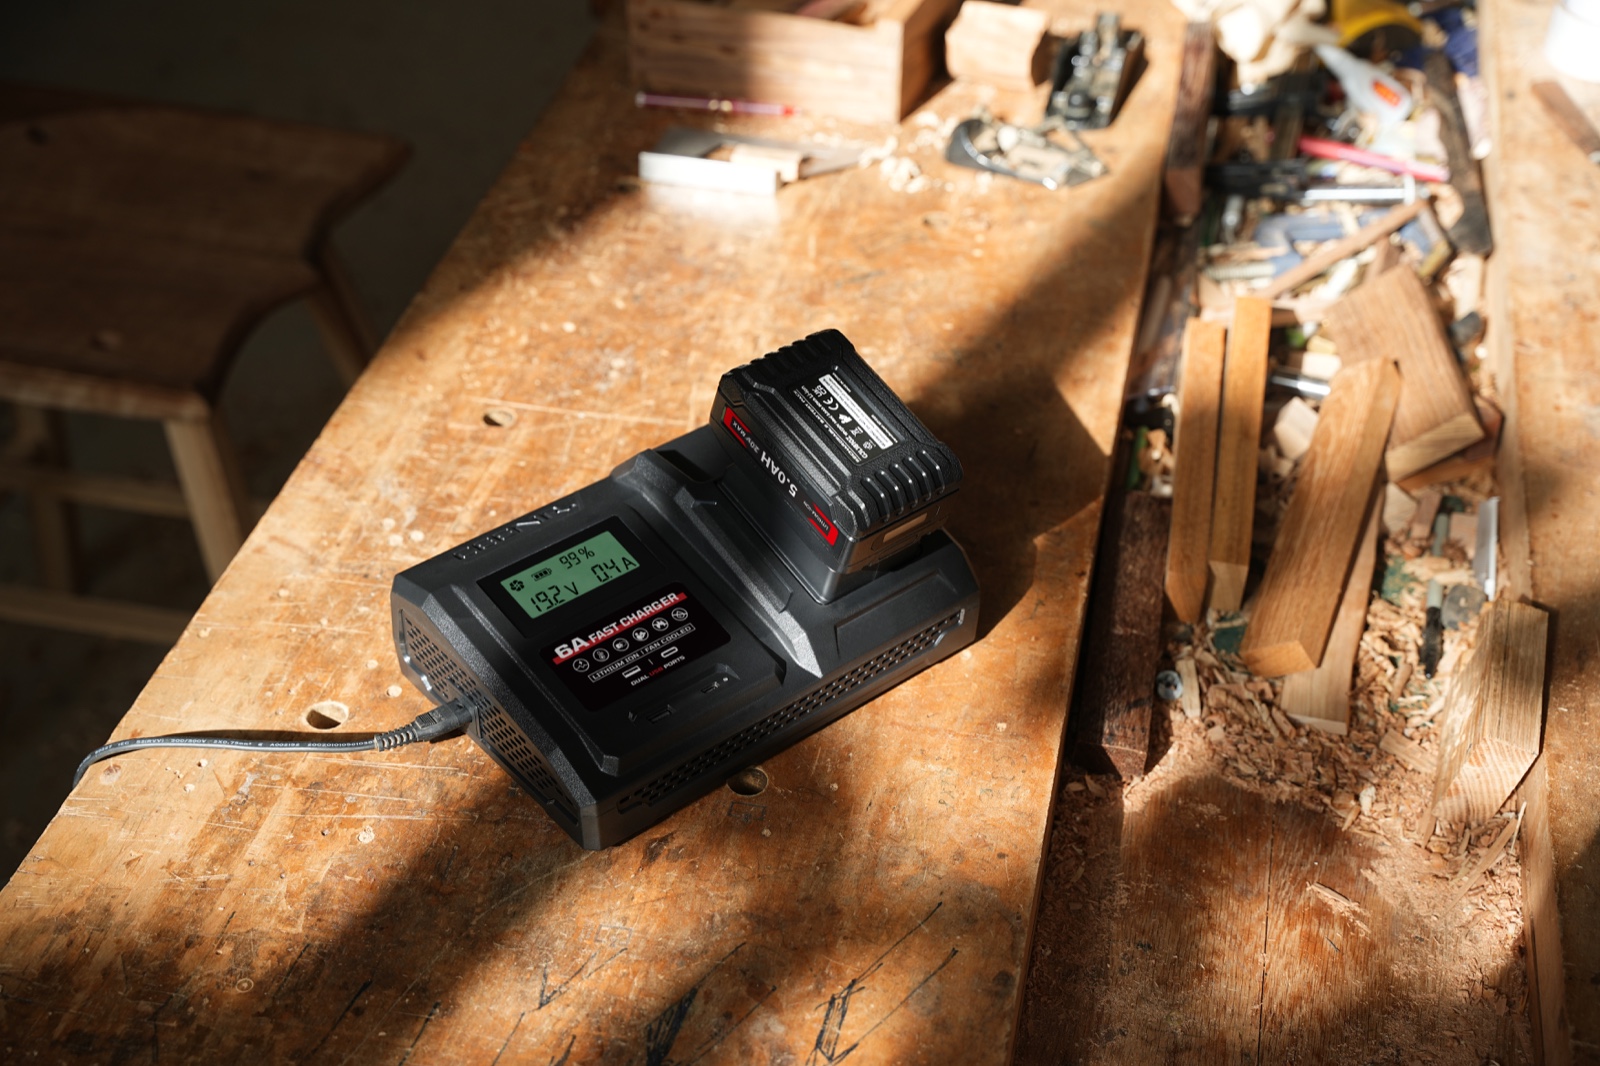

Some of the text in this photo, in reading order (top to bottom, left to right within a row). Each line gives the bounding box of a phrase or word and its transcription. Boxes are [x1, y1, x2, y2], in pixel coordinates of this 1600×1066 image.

[757, 449, 799, 498] 5.0AH
[560, 546, 595, 569] 99%
[591, 556, 637, 583] 0.4 A
[566, 581, 579, 596] V
[554, 592, 680, 660] 6A FAST CHARGER
[592, 626, 692, 680] LITHIUM ION FAN COOLED
[631, 655, 686, 686] DUAL USB PORTS
